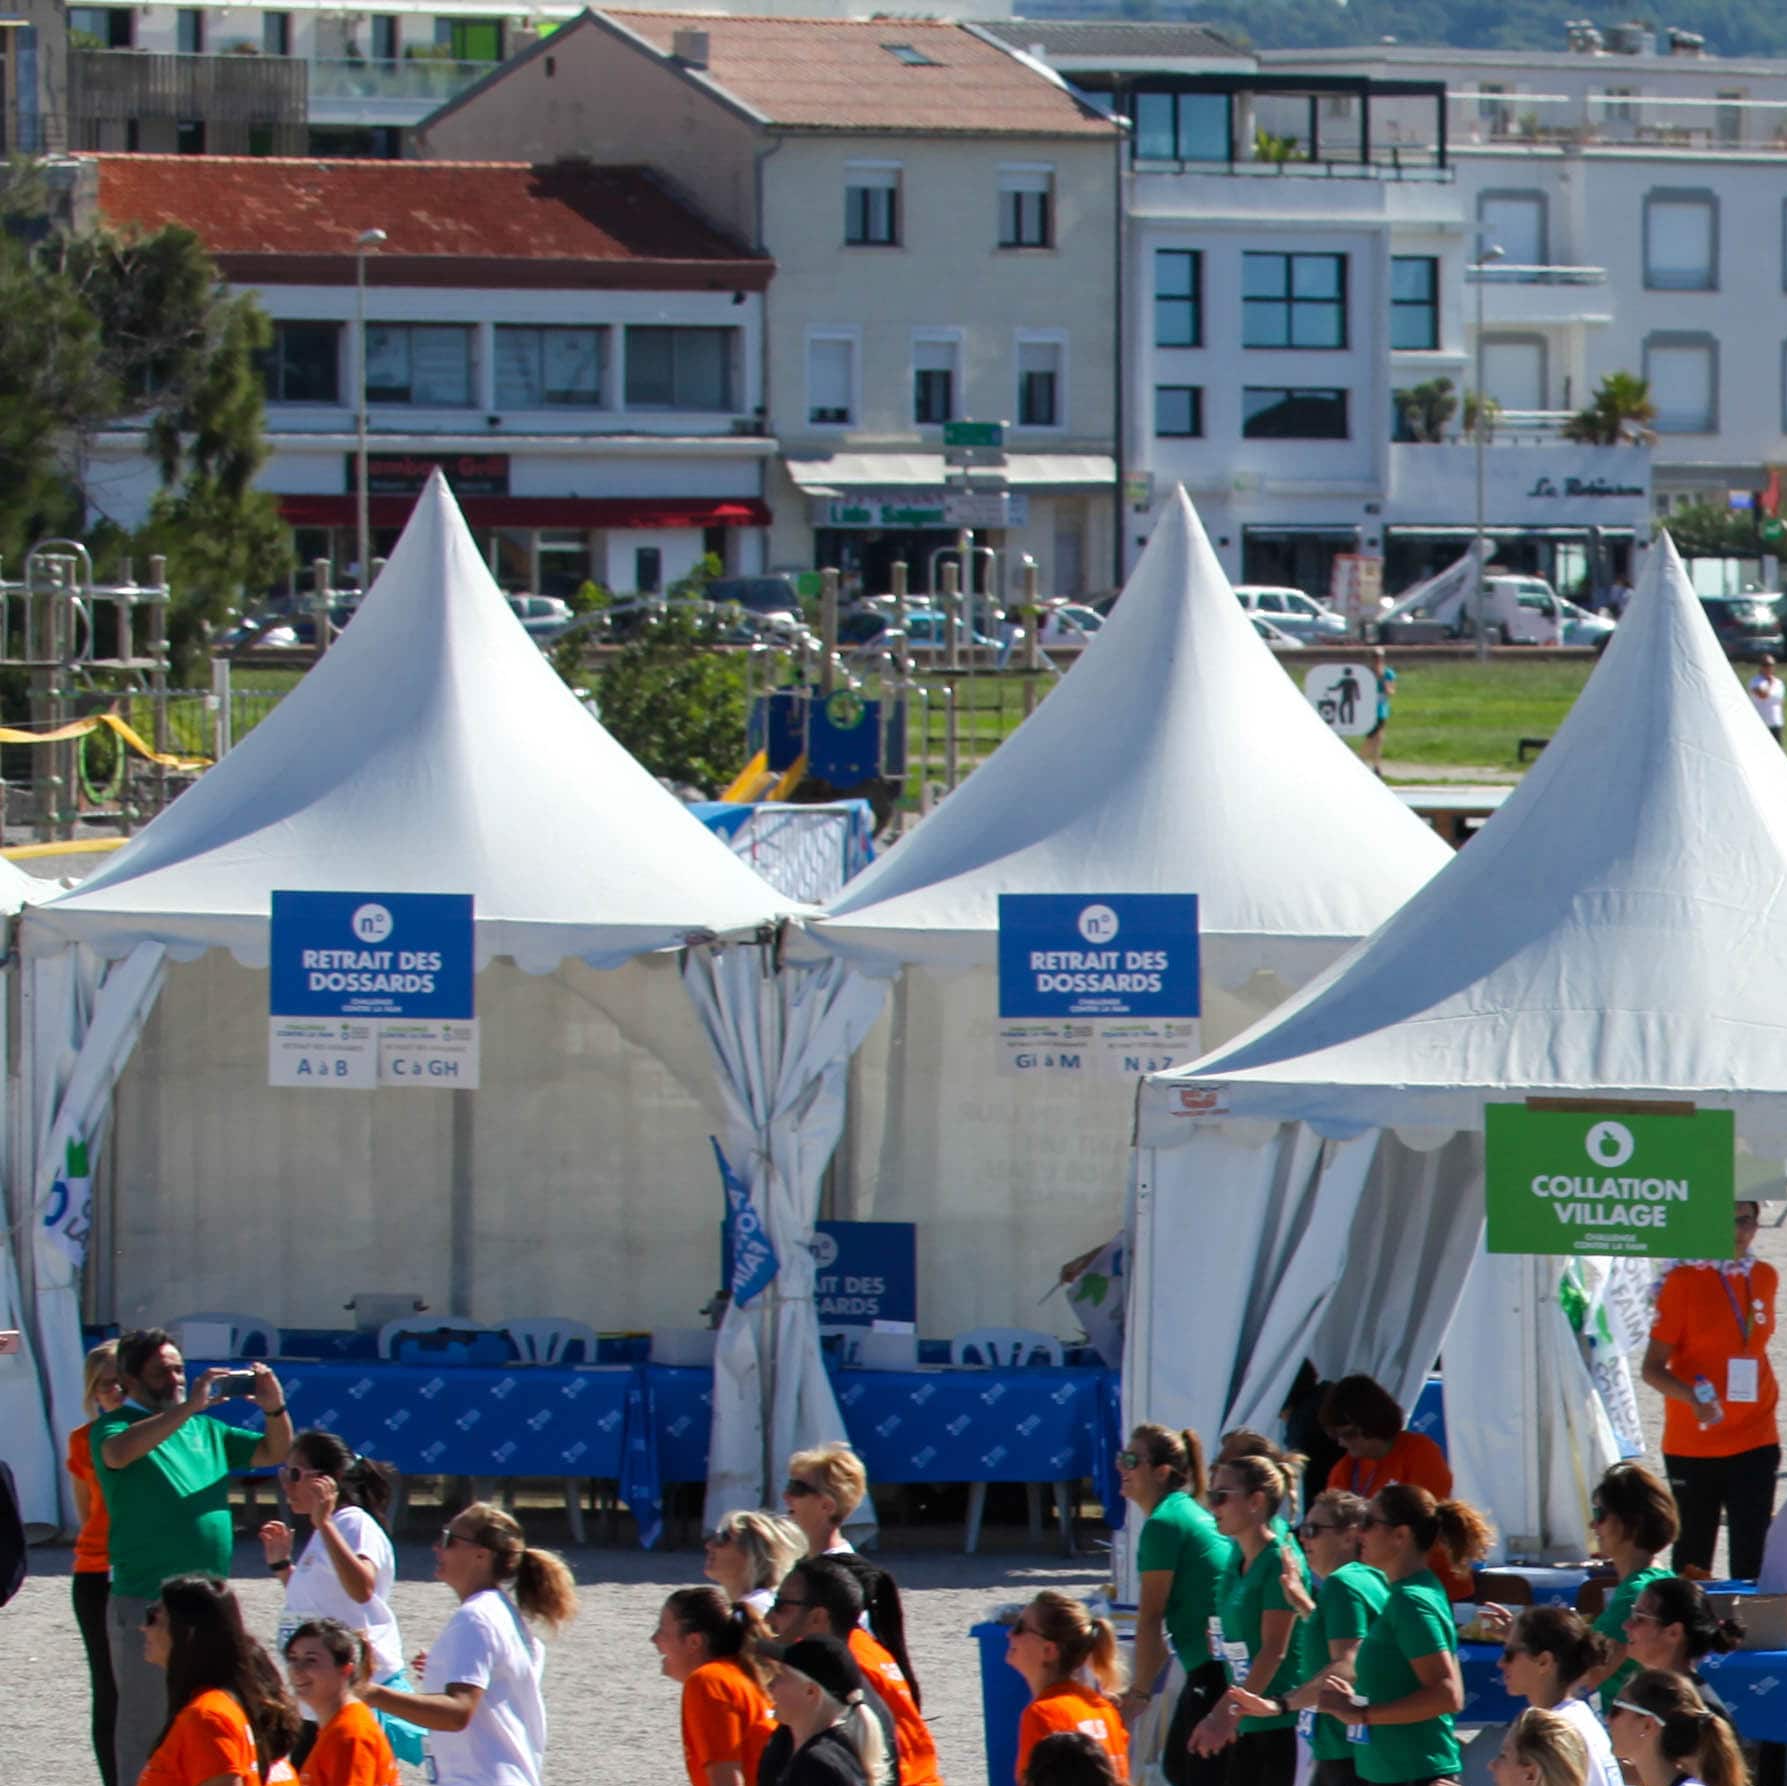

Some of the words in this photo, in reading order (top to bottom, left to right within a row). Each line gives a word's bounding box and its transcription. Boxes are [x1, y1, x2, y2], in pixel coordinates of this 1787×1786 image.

[303, 949, 394, 970] RETRAIT
[400, 952, 442, 972] DES
[1030, 951, 1120, 971] RETRAIT
[1125, 951, 1169, 971] DES
[308, 972, 435, 994] DOSSARDS
[1036, 973, 1163, 993] DOSSARDS
[297, 1058, 312, 1076] A
[335, 1059, 349, 1077] B
[392, 1058, 406, 1076] C
[427, 1059, 460, 1078] GH
[1060, 1054, 1081, 1070] M
[1124, 1056, 1140, 1072] N
[1530, 1174, 1688, 1202] COLLATION
[1553, 1202, 1667, 1228] VILLAGE
[845, 1277, 886, 1294] DES
[817, 1298, 880, 1316] ARDS
